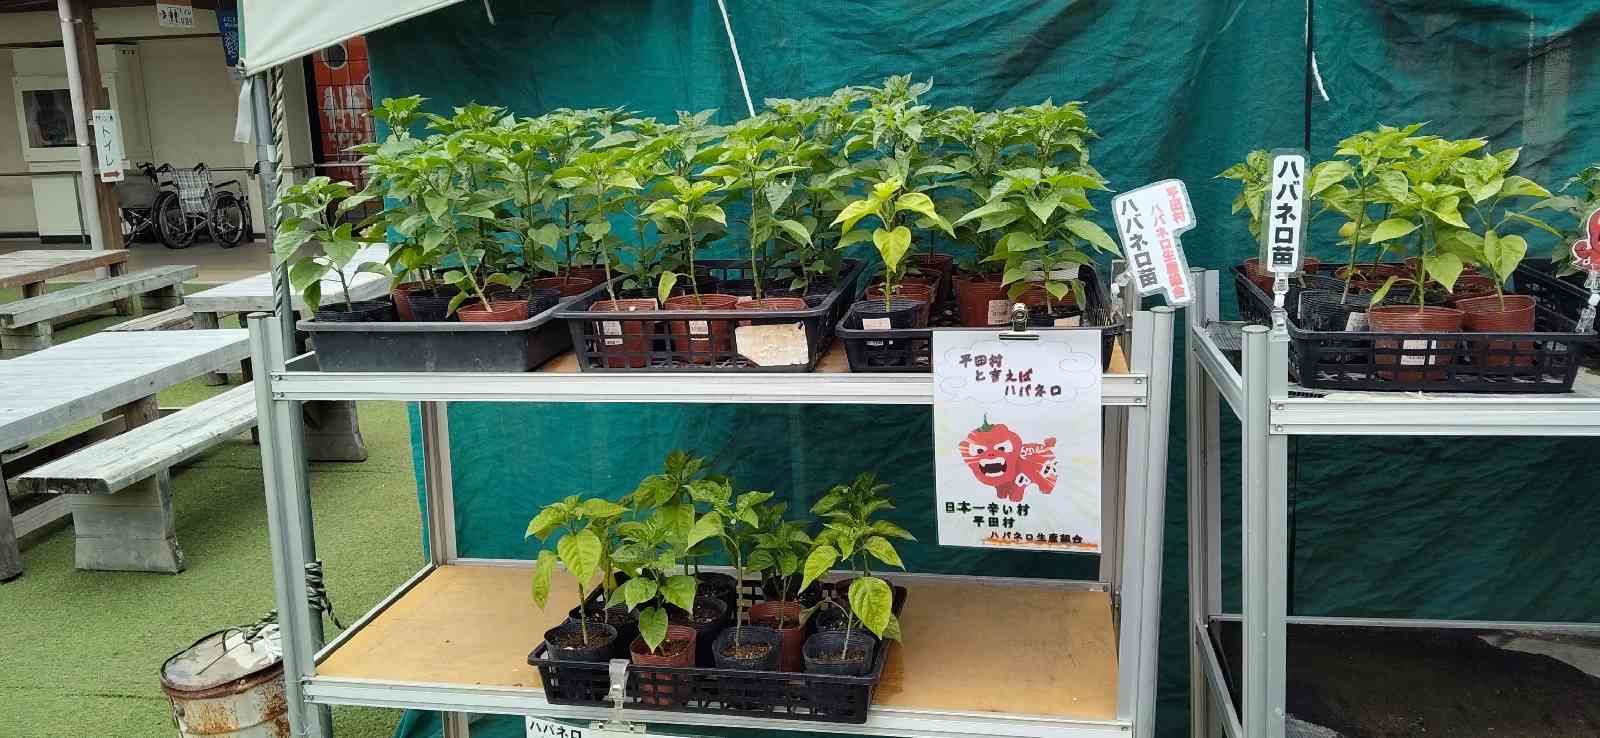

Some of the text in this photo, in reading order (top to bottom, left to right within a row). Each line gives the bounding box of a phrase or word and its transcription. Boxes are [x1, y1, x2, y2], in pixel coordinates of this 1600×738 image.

[1272, 160, 1301, 266] ハバネロ苗
[1121, 198, 1158, 288] ハバネロ苗
[959, 353, 1003, 368] 平田村
[975, 368, 1033, 383] と言えば
[1004, 384, 1062, 397] ハバネロ
[945, 501, 1031, 516] 日本一辛い村
[972, 516, 1016, 528] 平田村
